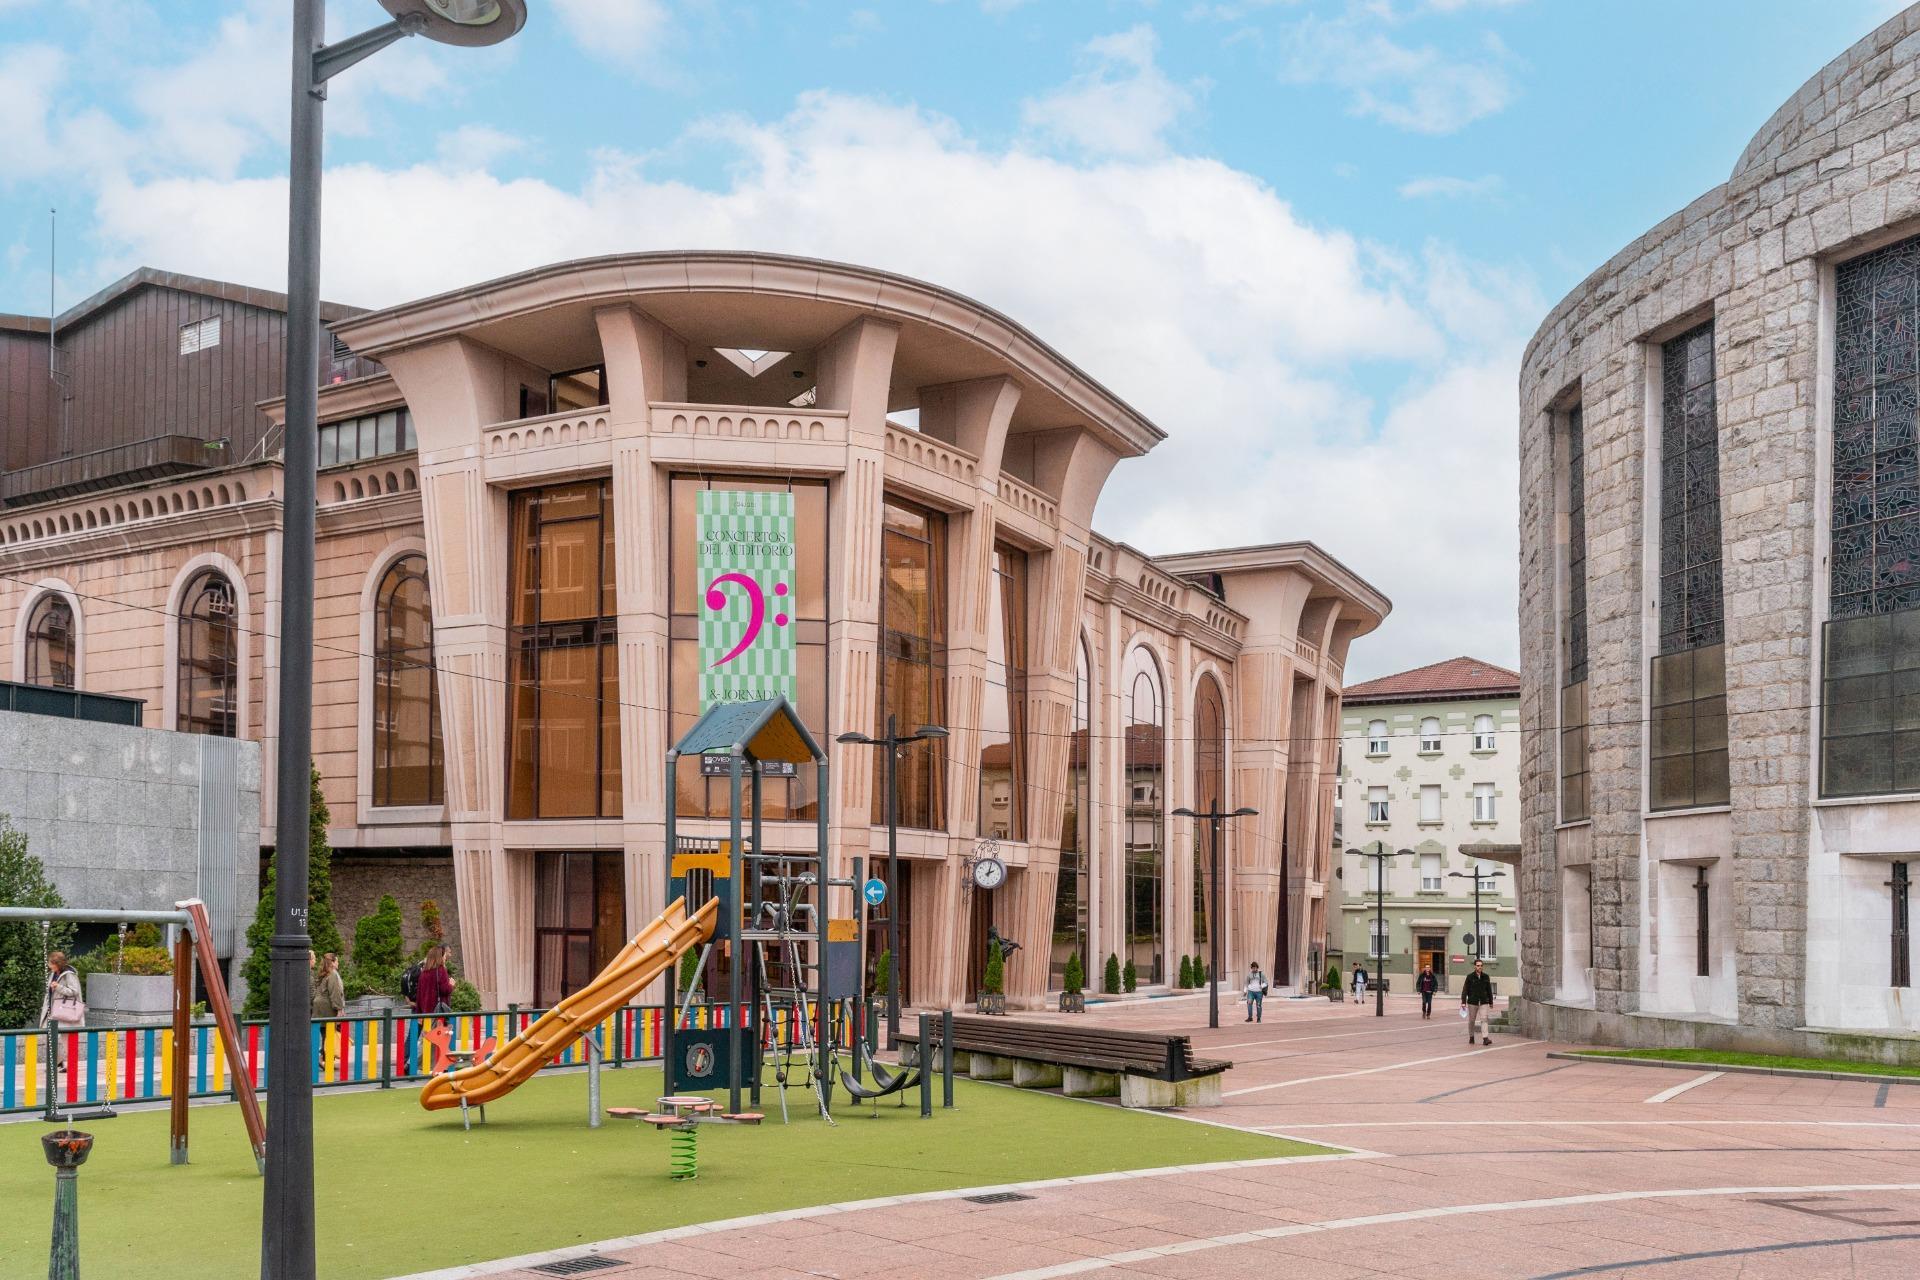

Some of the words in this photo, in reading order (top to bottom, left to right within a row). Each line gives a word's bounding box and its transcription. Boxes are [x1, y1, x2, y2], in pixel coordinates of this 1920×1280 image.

[706, 530, 786, 543] CONCIERTOS
[699, 543, 723, 555] DEL
[725, 544, 793, 557] AUDITORIO
